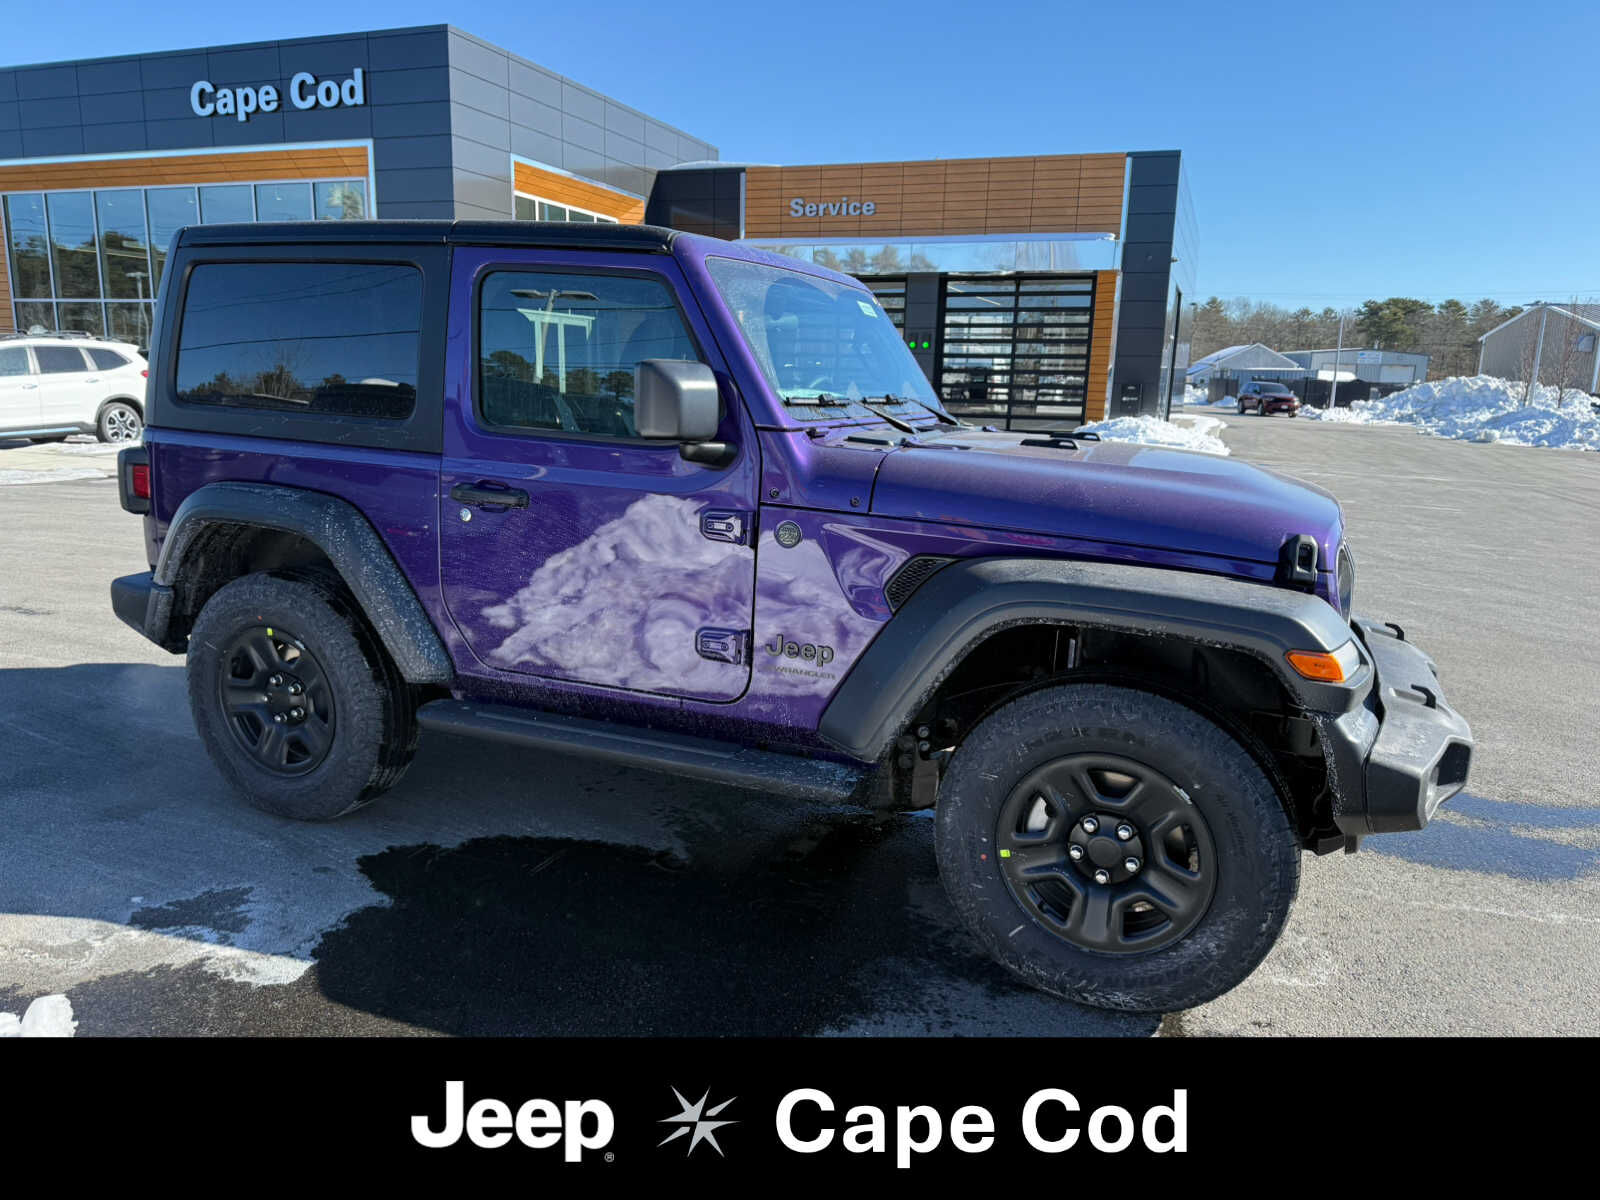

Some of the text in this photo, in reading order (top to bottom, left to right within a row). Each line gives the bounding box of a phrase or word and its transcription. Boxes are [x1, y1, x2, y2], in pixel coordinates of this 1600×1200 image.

[190, 67, 365, 122] Cape Cod
[789, 196, 876, 218] Service
[764, 633, 834, 667] Jeep
